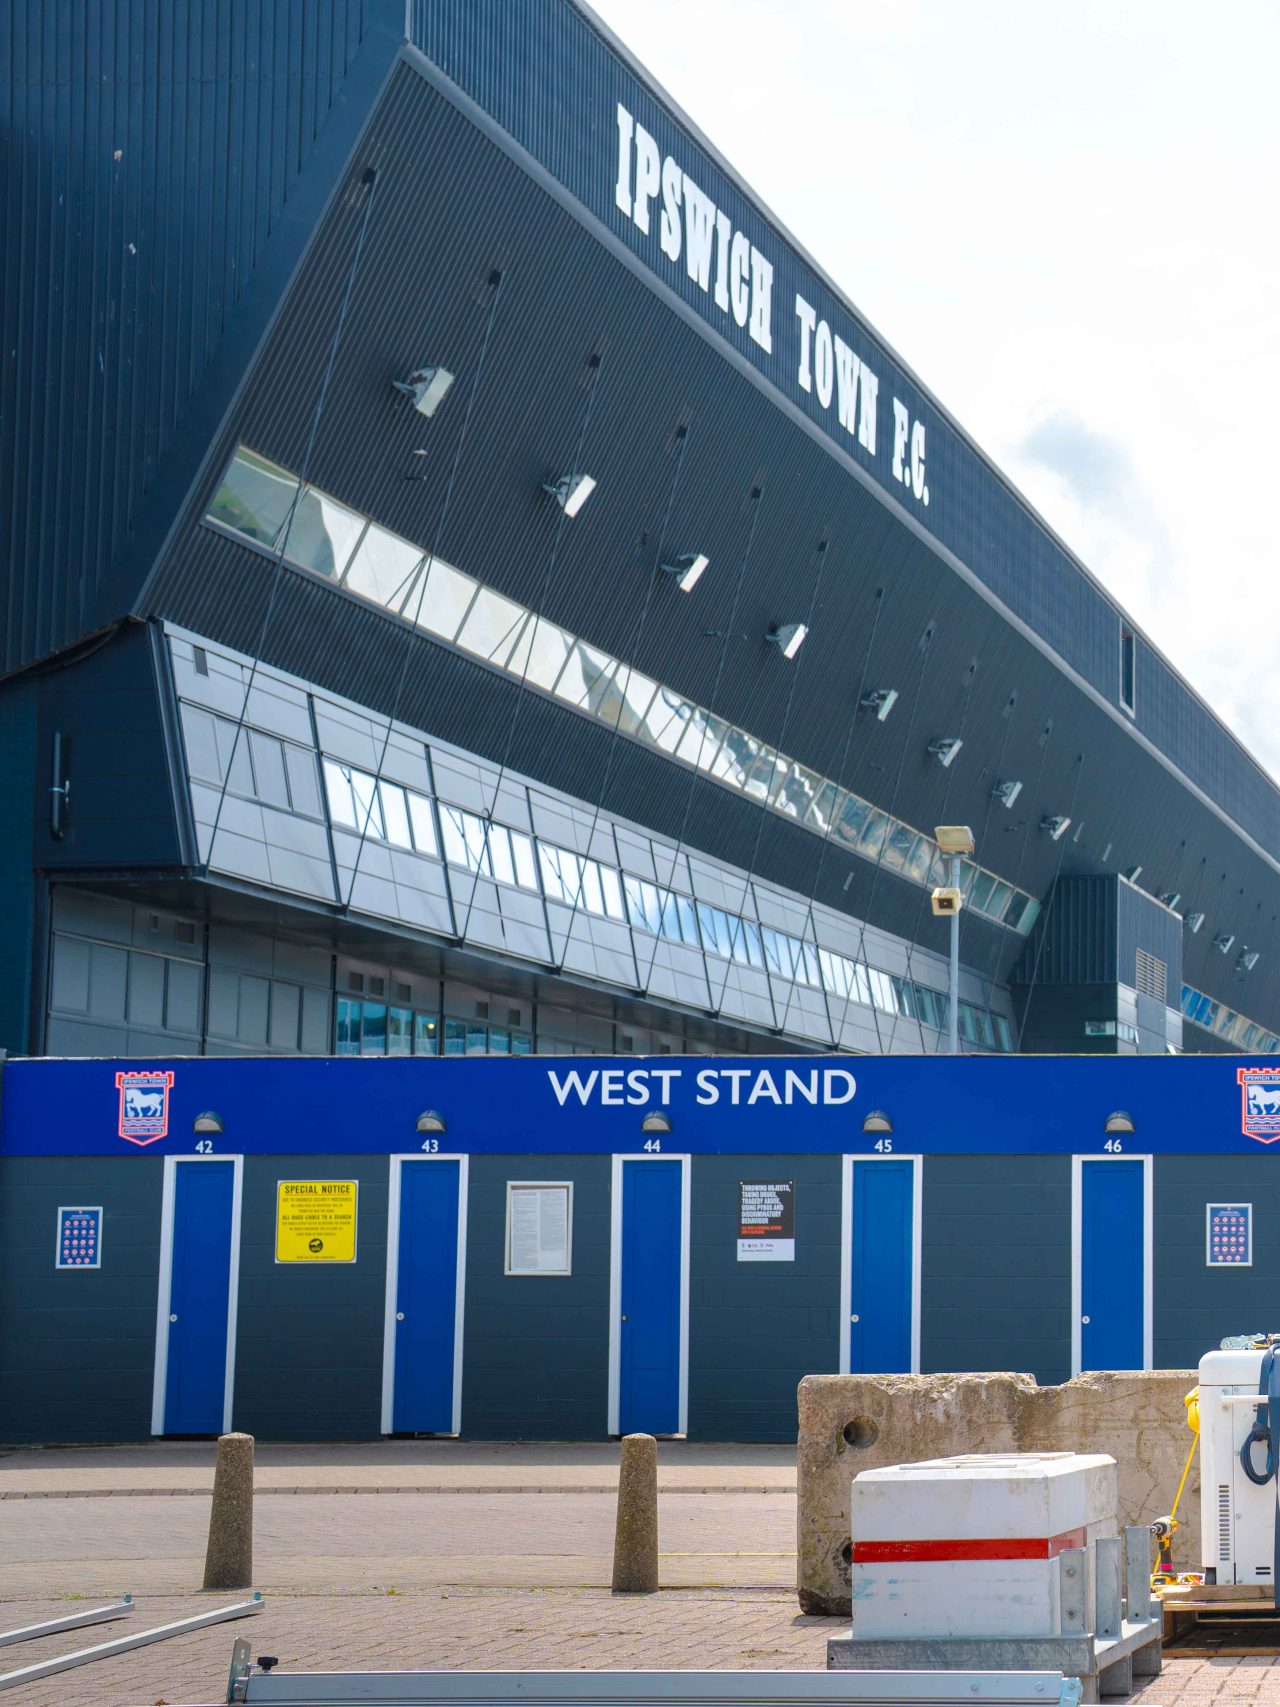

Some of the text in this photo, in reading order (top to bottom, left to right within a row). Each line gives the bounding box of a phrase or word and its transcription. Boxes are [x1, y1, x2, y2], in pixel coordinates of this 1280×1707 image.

[615, 102, 929, 507] IPSWICH TOWN F.C.
[547, 1069, 857, 1106] WEST STAND
[195, 1140, 213, 1154] 42
[421, 1139, 439, 1153] 43
[644, 1139, 661, 1152] 44
[874, 1139, 893, 1153] 45
[1103, 1139, 1122, 1153] 46
[285, 1185, 351, 1194] SPECIAL NOTICE
[768, 1184, 791, 1192] OBJECTS,
